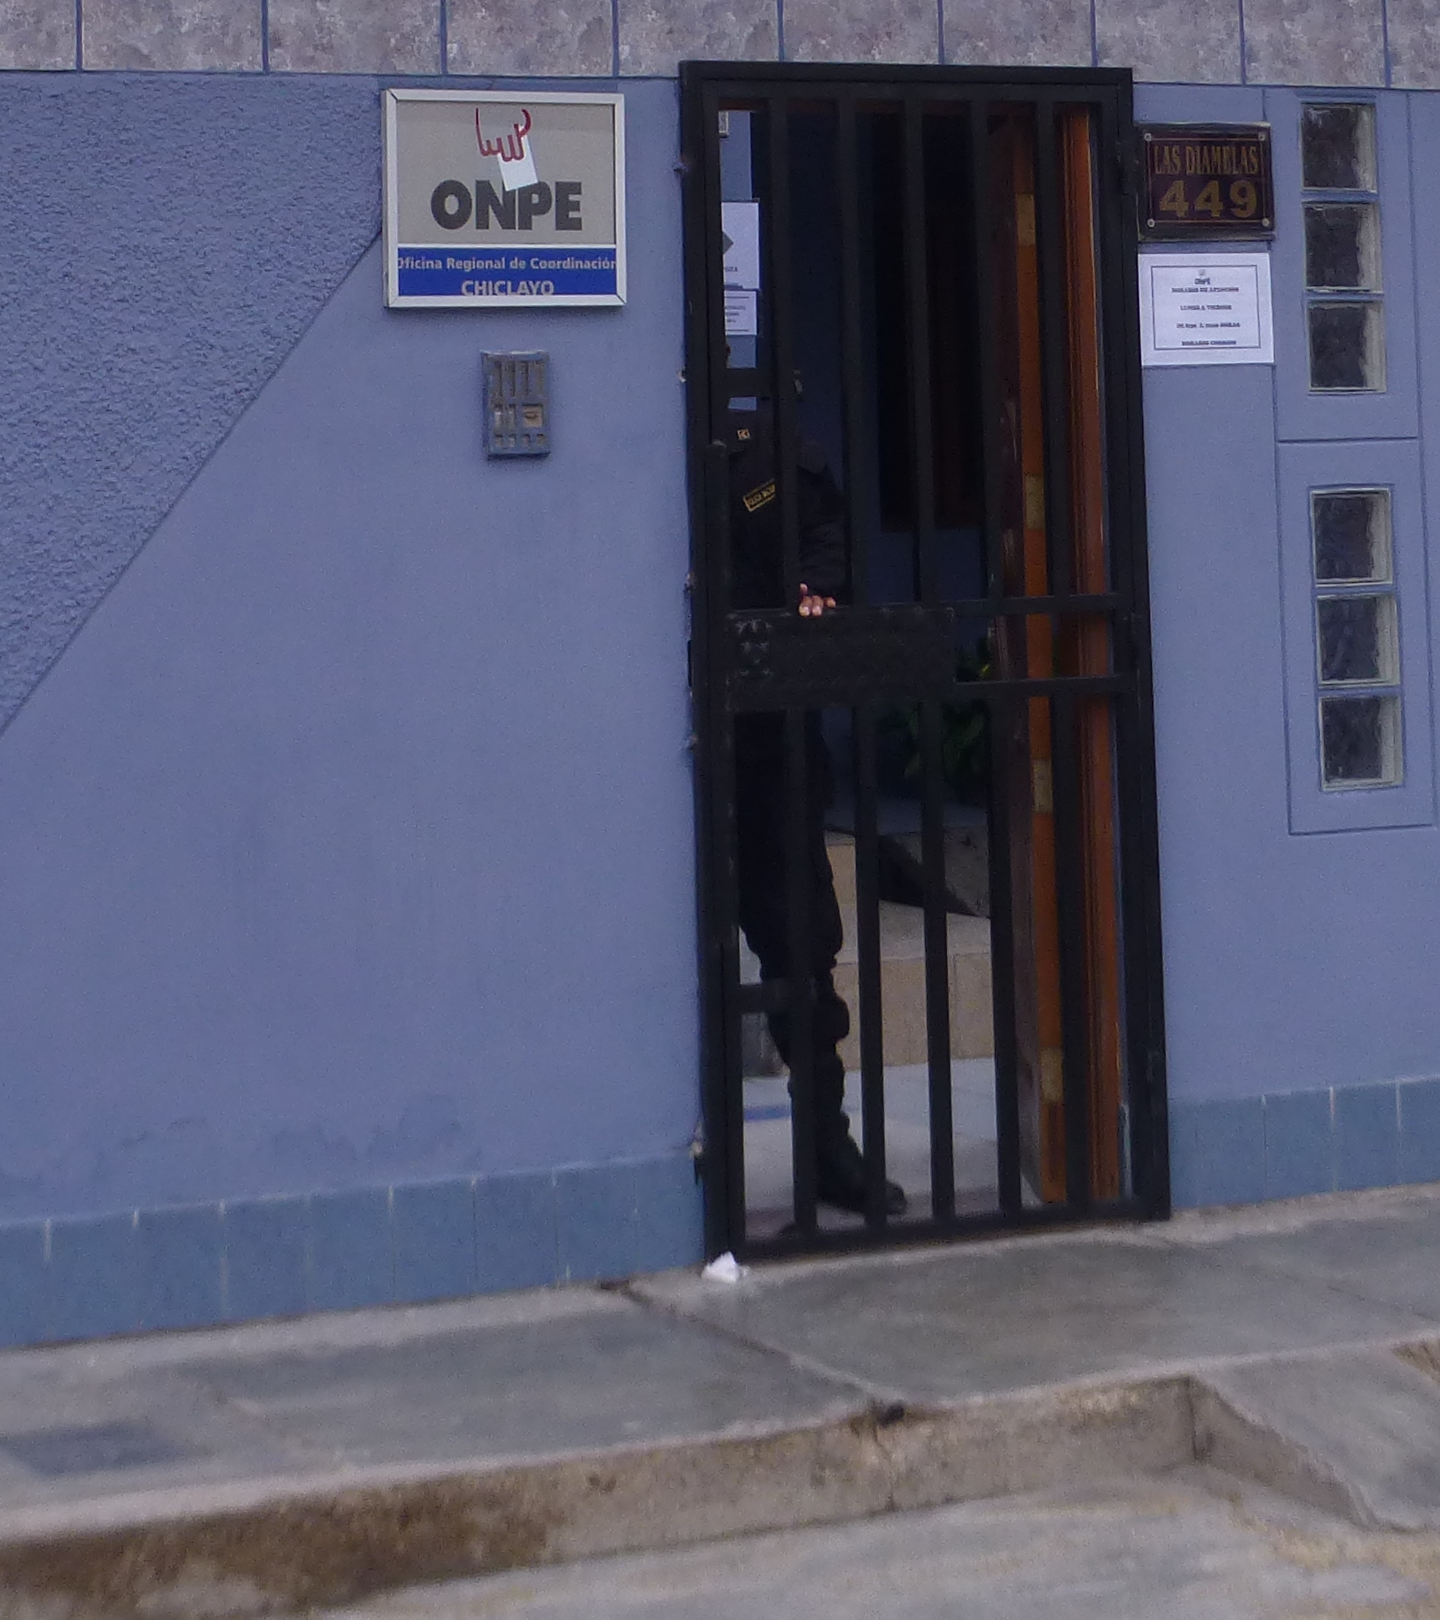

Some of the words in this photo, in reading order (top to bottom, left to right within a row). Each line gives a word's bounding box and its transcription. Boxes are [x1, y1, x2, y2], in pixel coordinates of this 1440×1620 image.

[1154, 145, 1181, 175] LAS
[1185, 144, 1259, 175] DIAMELAS
[430, 179, 582, 230] ONPE
[1159, 180, 1257, 218] 449
[447, 257, 505, 272] Regional
[510, 257, 526, 269] de
[461, 280, 554, 296] CHICLAYO
